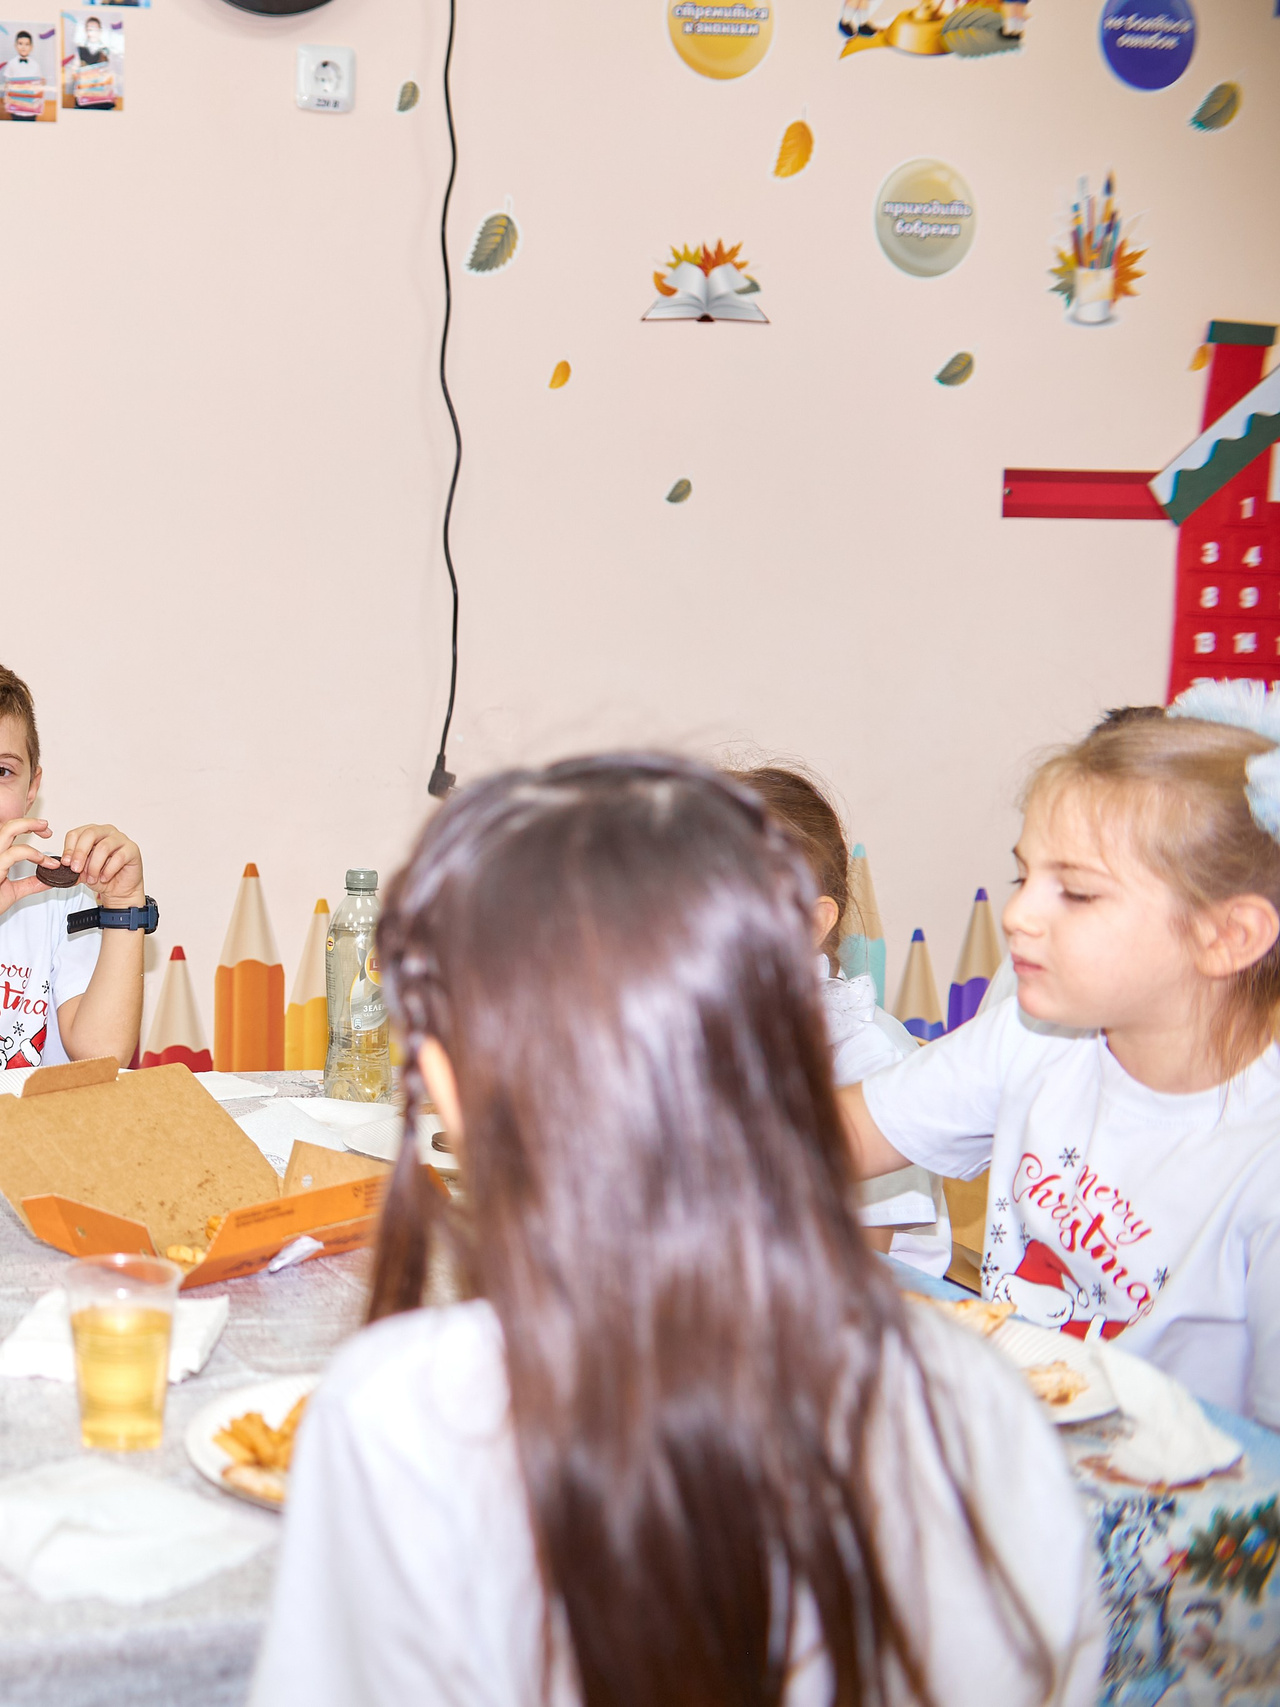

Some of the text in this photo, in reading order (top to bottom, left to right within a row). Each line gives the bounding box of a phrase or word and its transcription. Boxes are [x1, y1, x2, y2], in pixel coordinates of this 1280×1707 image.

[674, 2, 769, 21] стремиться
[883, 199, 972, 219] приходить
[894, 218, 961, 239] вовремя
[1240, 497, 1256, 519] 1
[1200, 541, 1220, 565] 3
[1242, 546, 1262, 568] 4
[1200, 586, 1219, 609] 8
[1239, 586, 1259, 609] 9
[1193, 631, 1216, 654] 13
[1233, 631, 1257, 654] 14
[1074, 1165, 1152, 1244] Merry
